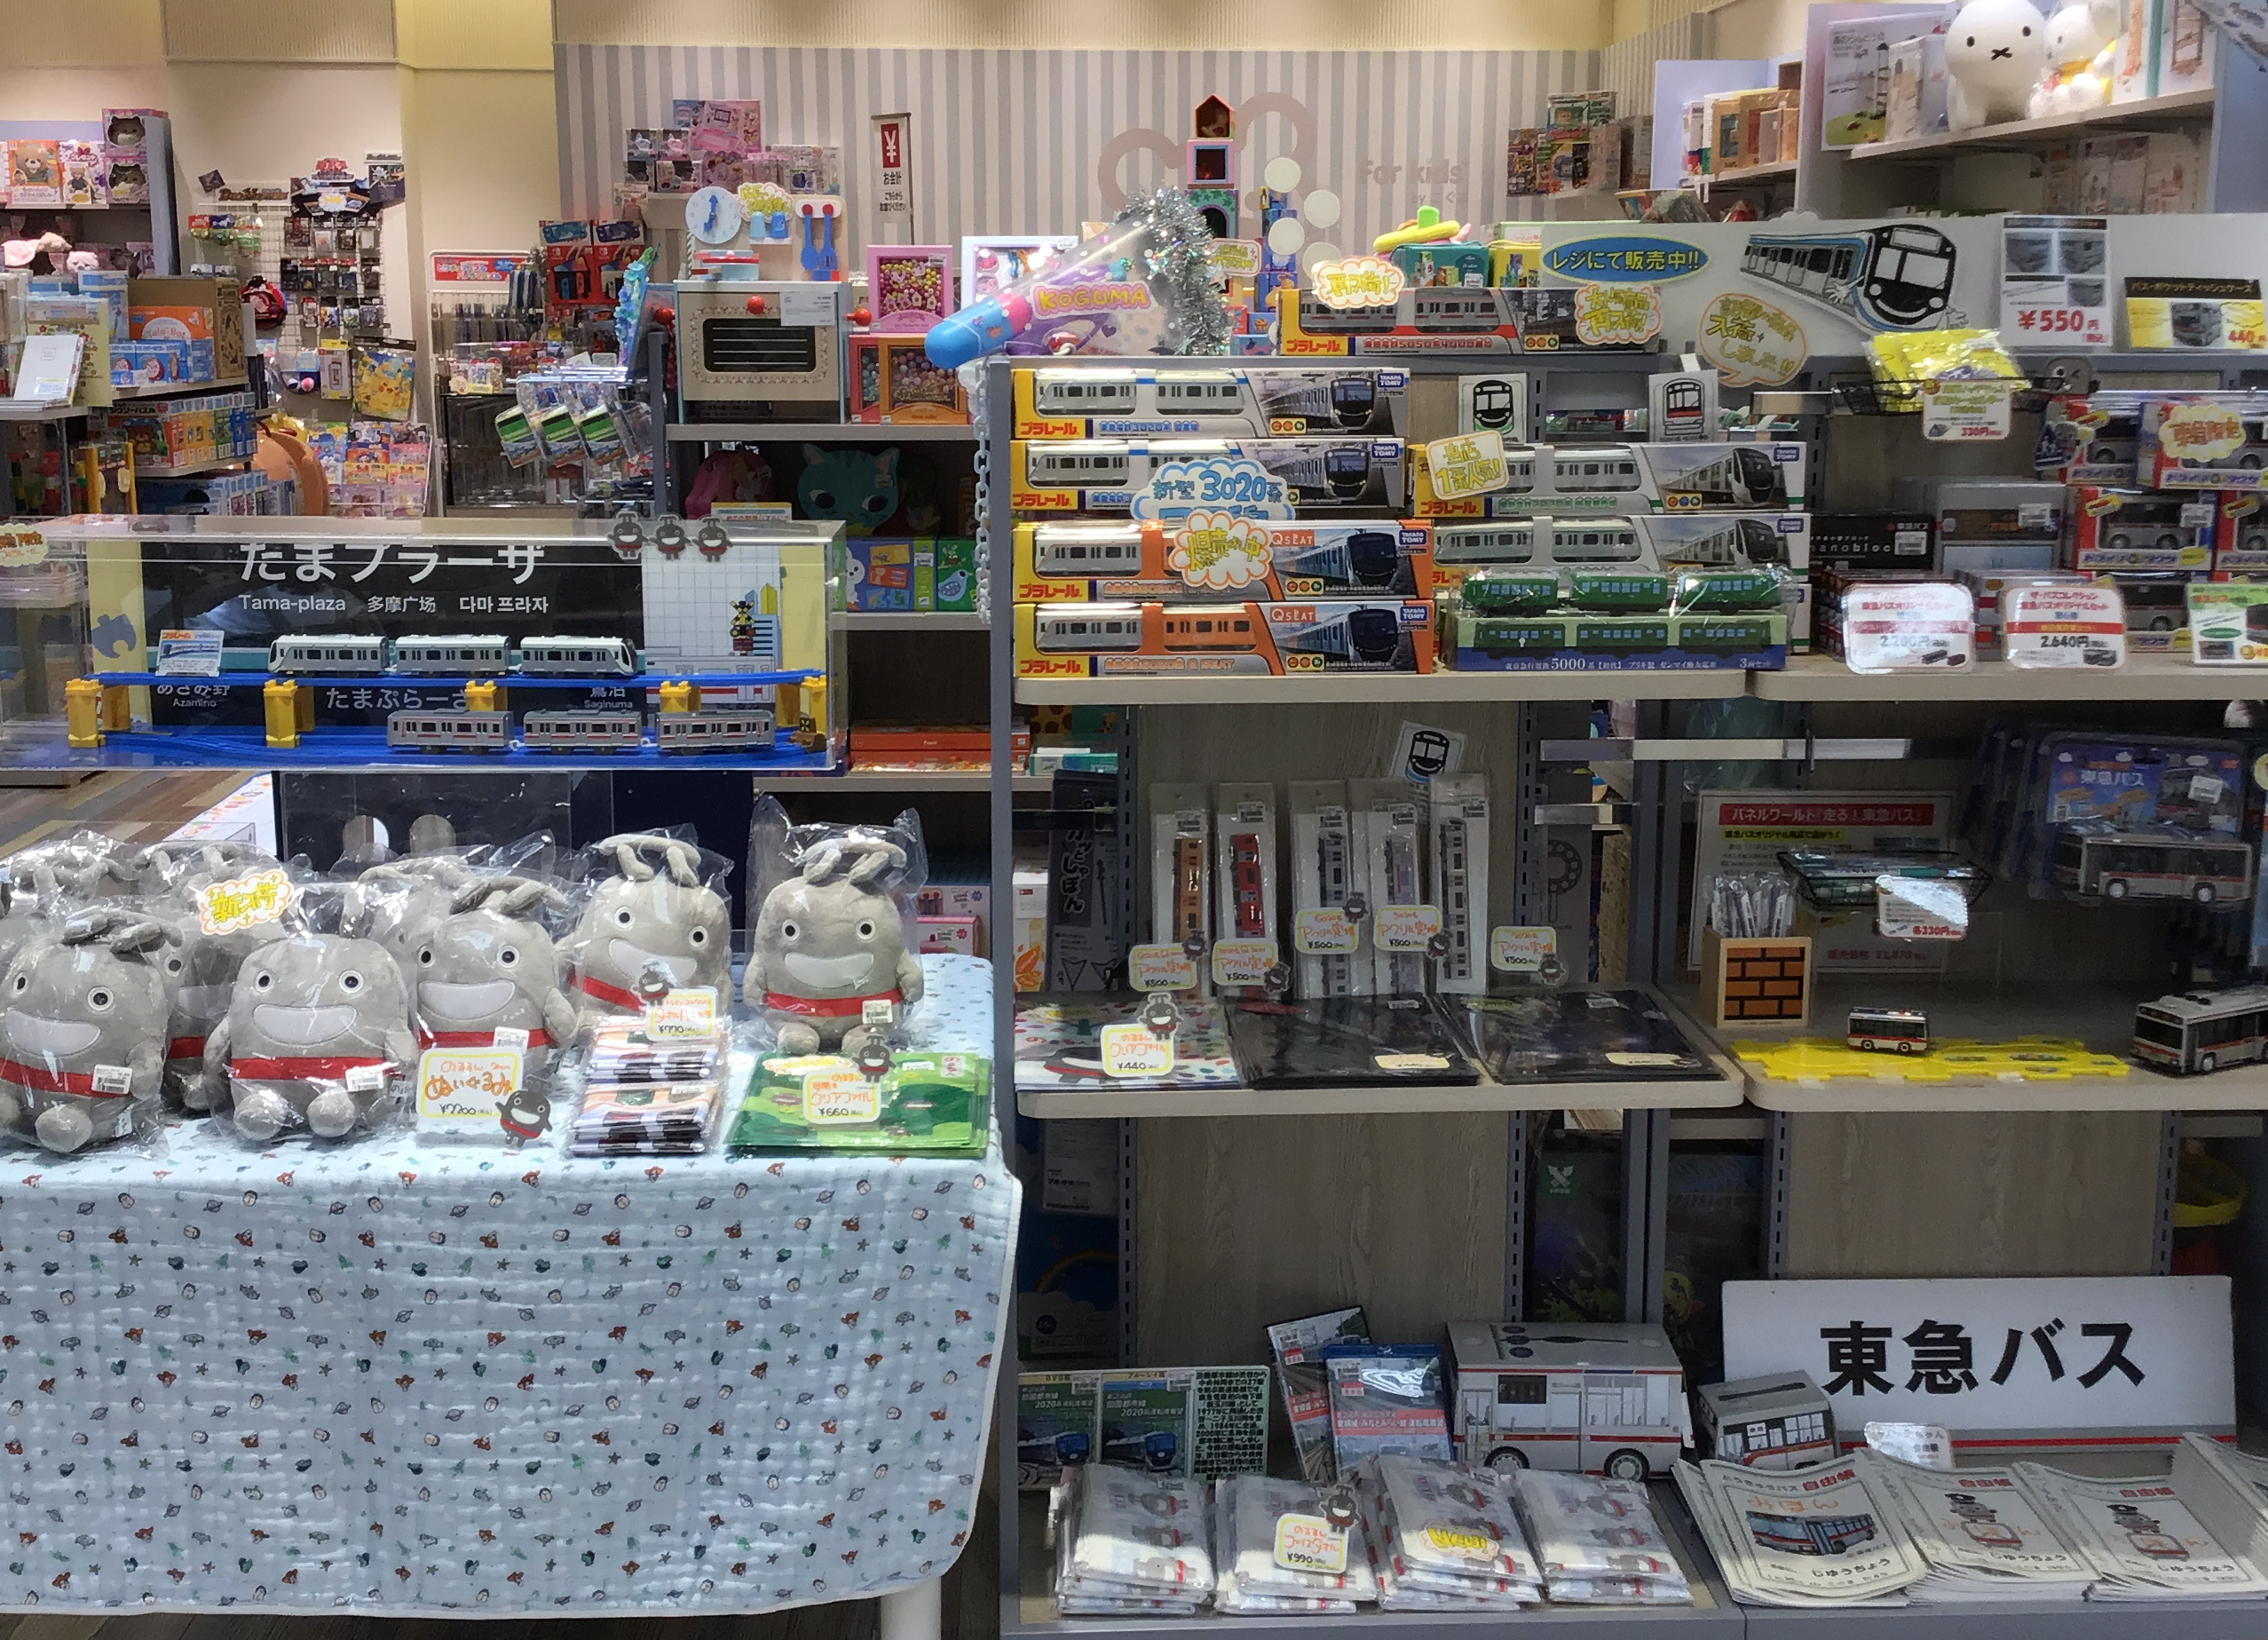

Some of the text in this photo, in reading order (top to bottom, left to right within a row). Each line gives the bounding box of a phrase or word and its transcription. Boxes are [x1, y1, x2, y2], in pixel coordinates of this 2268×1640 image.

[1038, 288, 1148, 312] KOGUMA
[2017, 308, 2084, 332] ¥550
[1286, 339, 1341, 353] プラレール
[1021, 422, 1078, 435] プラレール
[1013, 493, 1071, 507] プラレール
[1420, 500, 1477, 515] プラレール
[1810, 543, 1892, 552] nanobloc
[1019, 583, 1080, 598] プラレール
[239, 594, 346, 614] Tama-plaza
[367, 596, 436, 614] 多摩广场
[459, 596, 549, 614] 다마 프라자
[1020, 659, 1081, 673] プラレール
[173, 698, 217, 709] Azamino
[584, 700, 634, 710] Saginuma
[1389, 938, 1411, 947] ¥500
[1504, 955, 1529, 964] ¥500
[1144, 978, 1168, 987] ¥500
[1226, 972, 1250, 981] ¥500
[1117, 1061, 1147, 1070] ¥440
[425, 1072, 513, 1100] ぬいぐるみ
[818, 1107, 850, 1117] ¥660
[1820, 1317, 2146, 1396] 東急バス
[1287, 1552, 1314, 1564] ¥990
